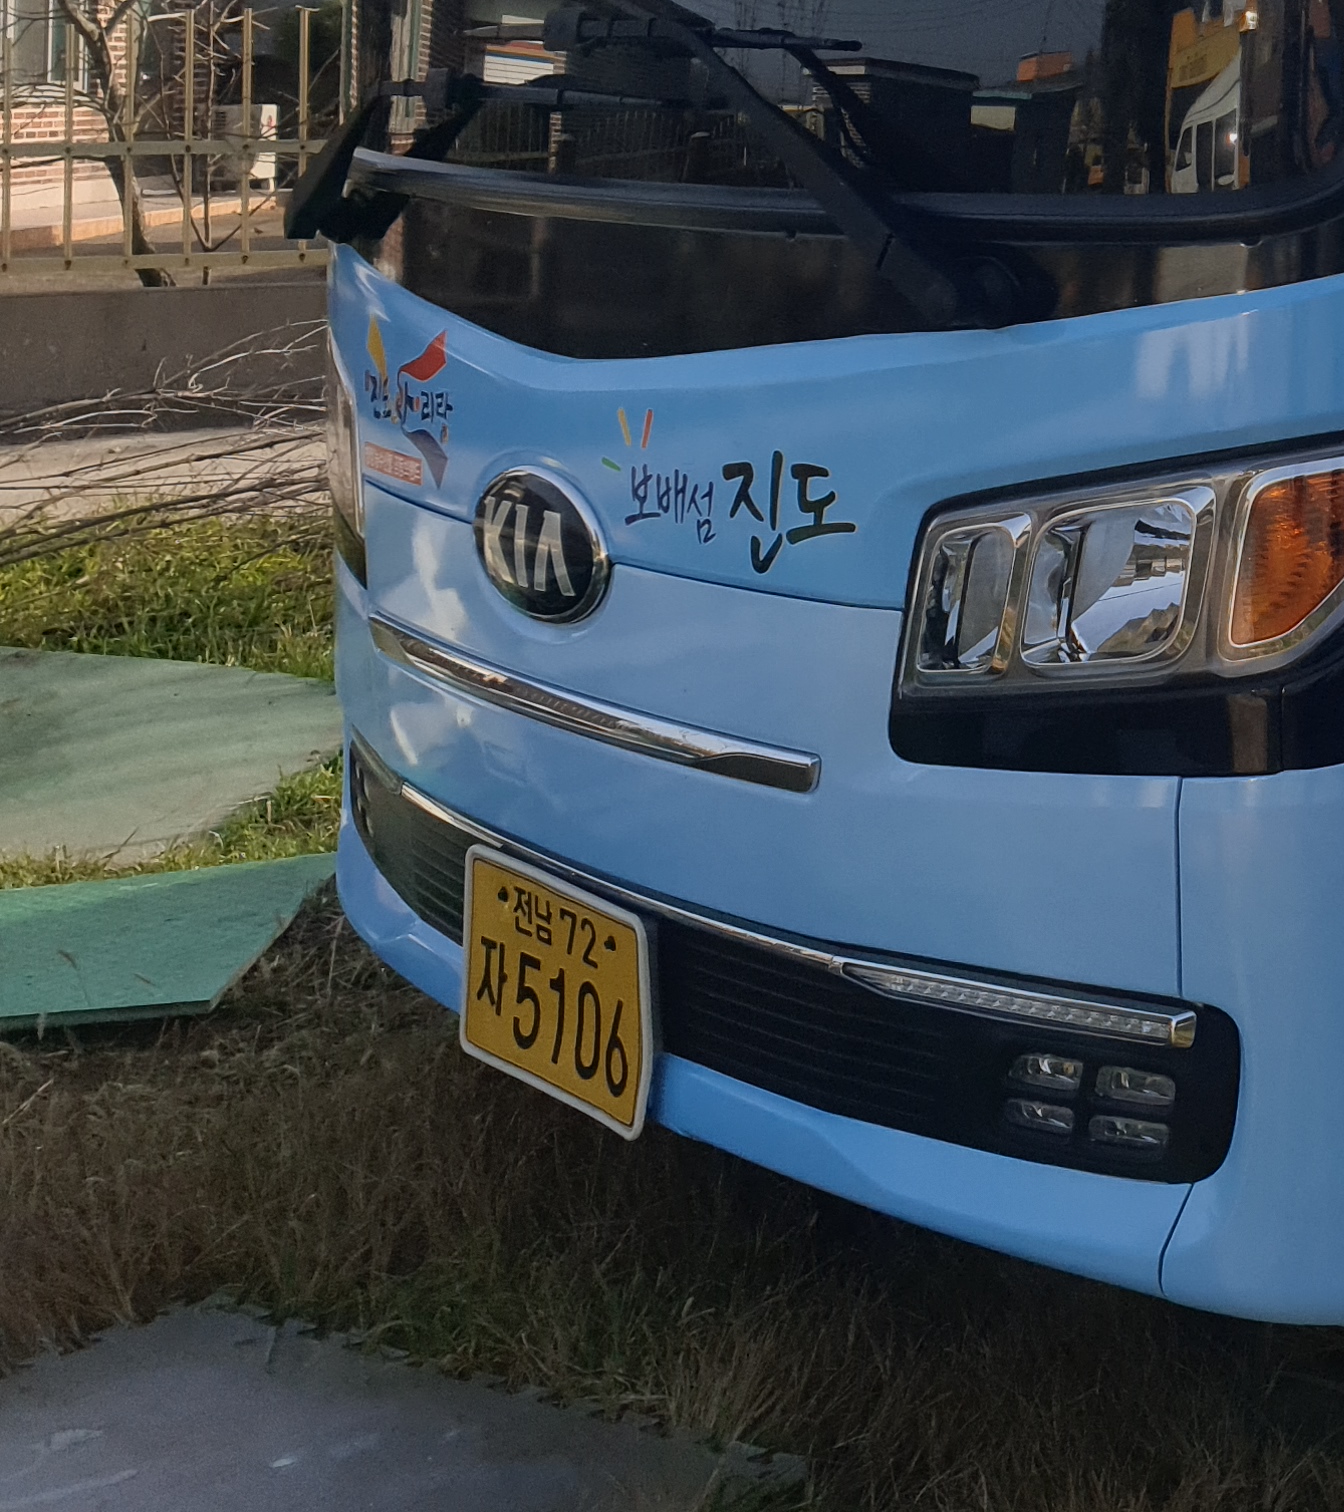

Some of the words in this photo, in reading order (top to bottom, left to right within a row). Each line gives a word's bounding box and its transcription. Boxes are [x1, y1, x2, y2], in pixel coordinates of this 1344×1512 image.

[483, 495, 576, 597] KIA
[625, 464, 717, 545] 보배섬
[722, 450, 856, 574] 진도
